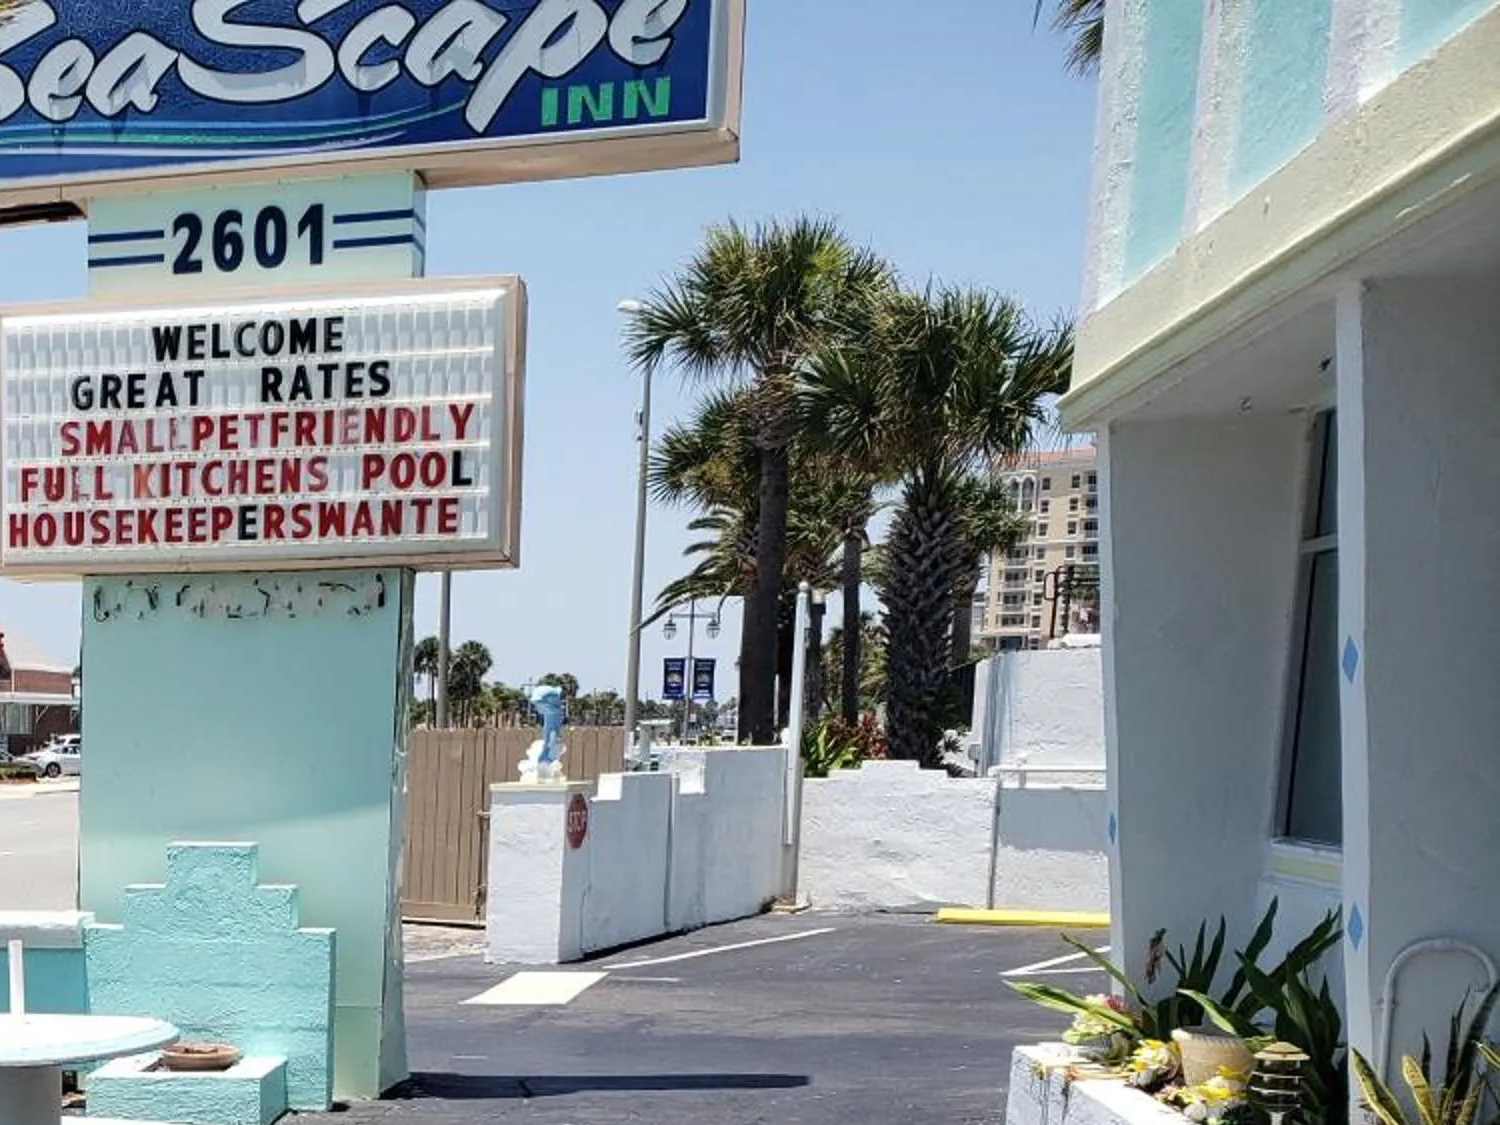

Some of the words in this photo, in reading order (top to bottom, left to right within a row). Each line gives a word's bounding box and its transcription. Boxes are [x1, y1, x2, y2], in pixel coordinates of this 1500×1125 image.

[541, 76, 671, 127] INN
[171, 204, 324, 275] 2601
[152, 316, 345, 362] WELCOME
[71, 369, 205, 411] GREAT
[260, 360, 391, 402] RATES
[20, 464, 113, 502] FULL
[132, 455, 330, 499] KITCHENS
[361, 449, 473, 490] POOL
